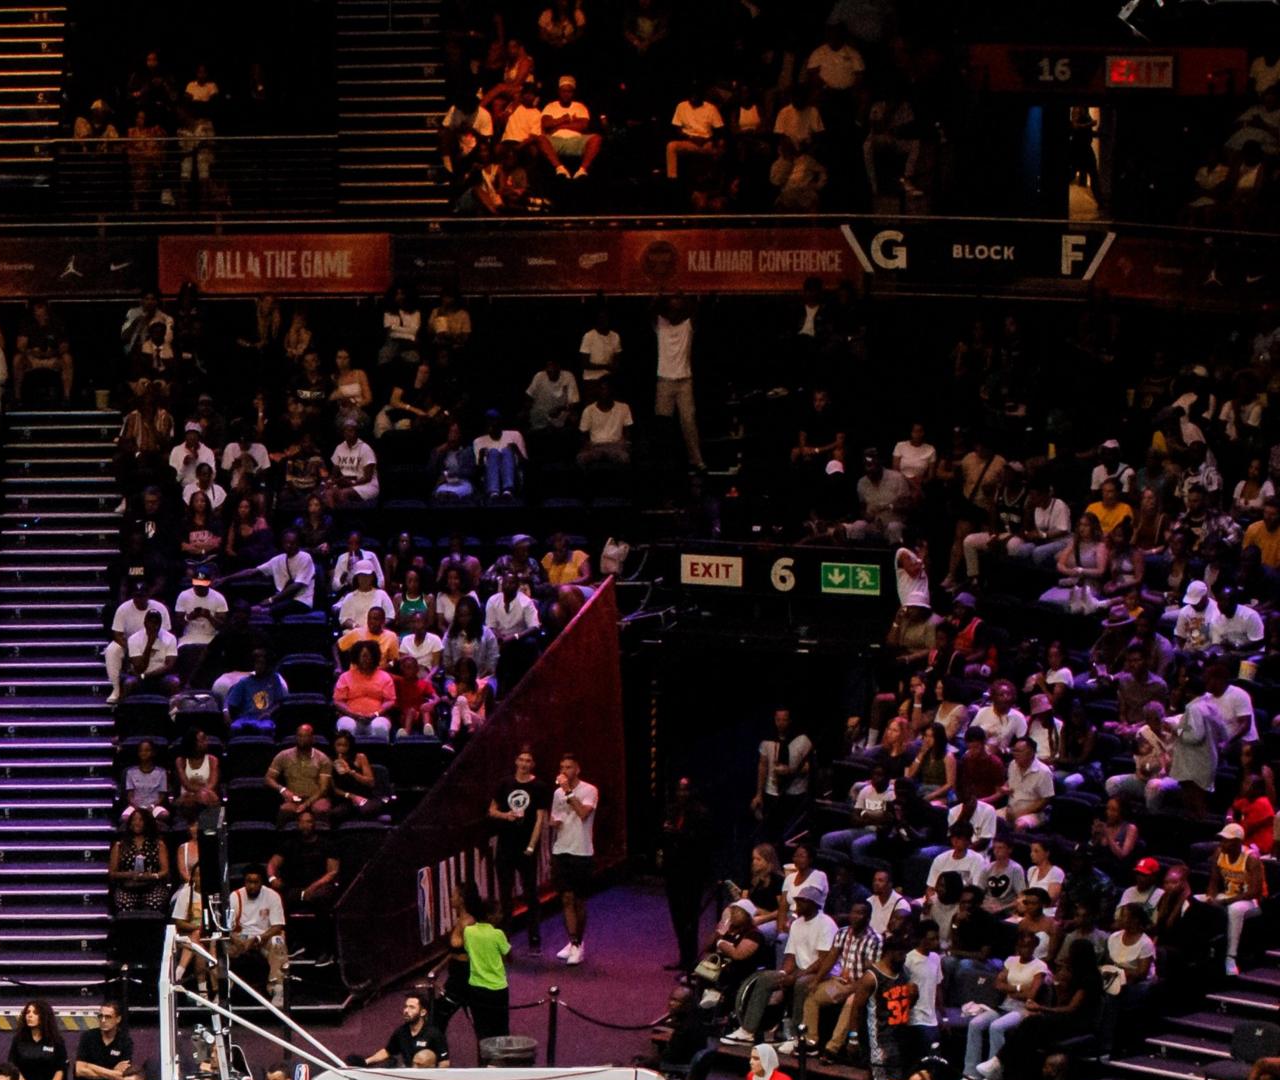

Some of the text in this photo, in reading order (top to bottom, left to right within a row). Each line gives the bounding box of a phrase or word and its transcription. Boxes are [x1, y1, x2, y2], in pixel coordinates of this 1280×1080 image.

[1037, 58, 1071, 81] 16
[263, 250, 297, 279] THE
[300, 250, 353, 279] GAME
[687, 250, 842, 272] KALAHARI CONFERENCE
[871, 229, 1087, 275] G BLOCK F
[690, 561, 733, 579] EXIT
[770, 557, 796, 592] 6
